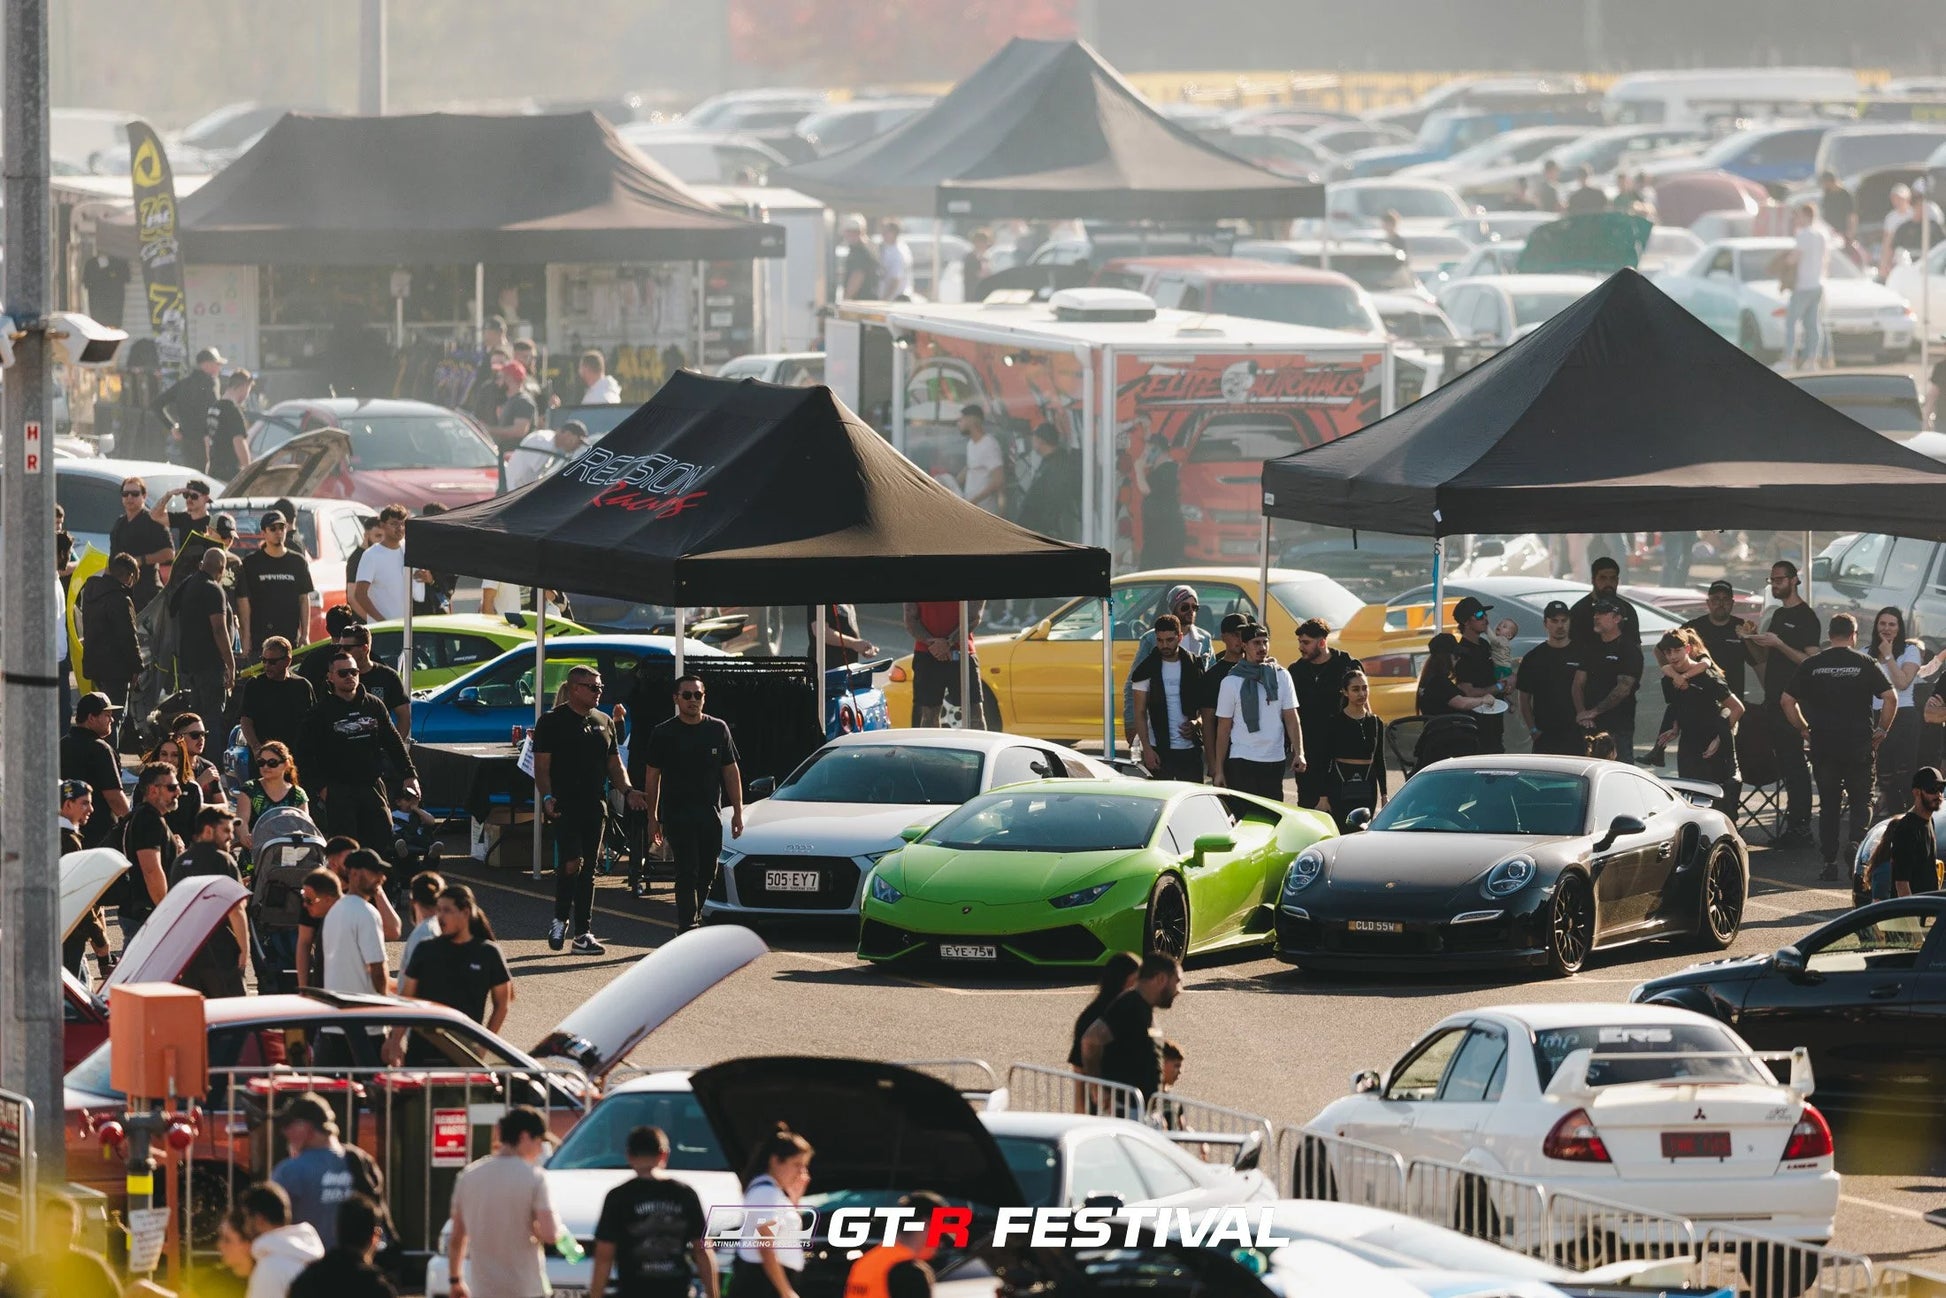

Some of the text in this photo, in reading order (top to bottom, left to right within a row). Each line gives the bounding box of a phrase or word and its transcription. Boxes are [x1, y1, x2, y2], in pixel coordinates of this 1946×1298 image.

[27, 425, 38, 440] H
[27, 455, 38, 470] R
[1355, 920, 1374, 931] CLD
